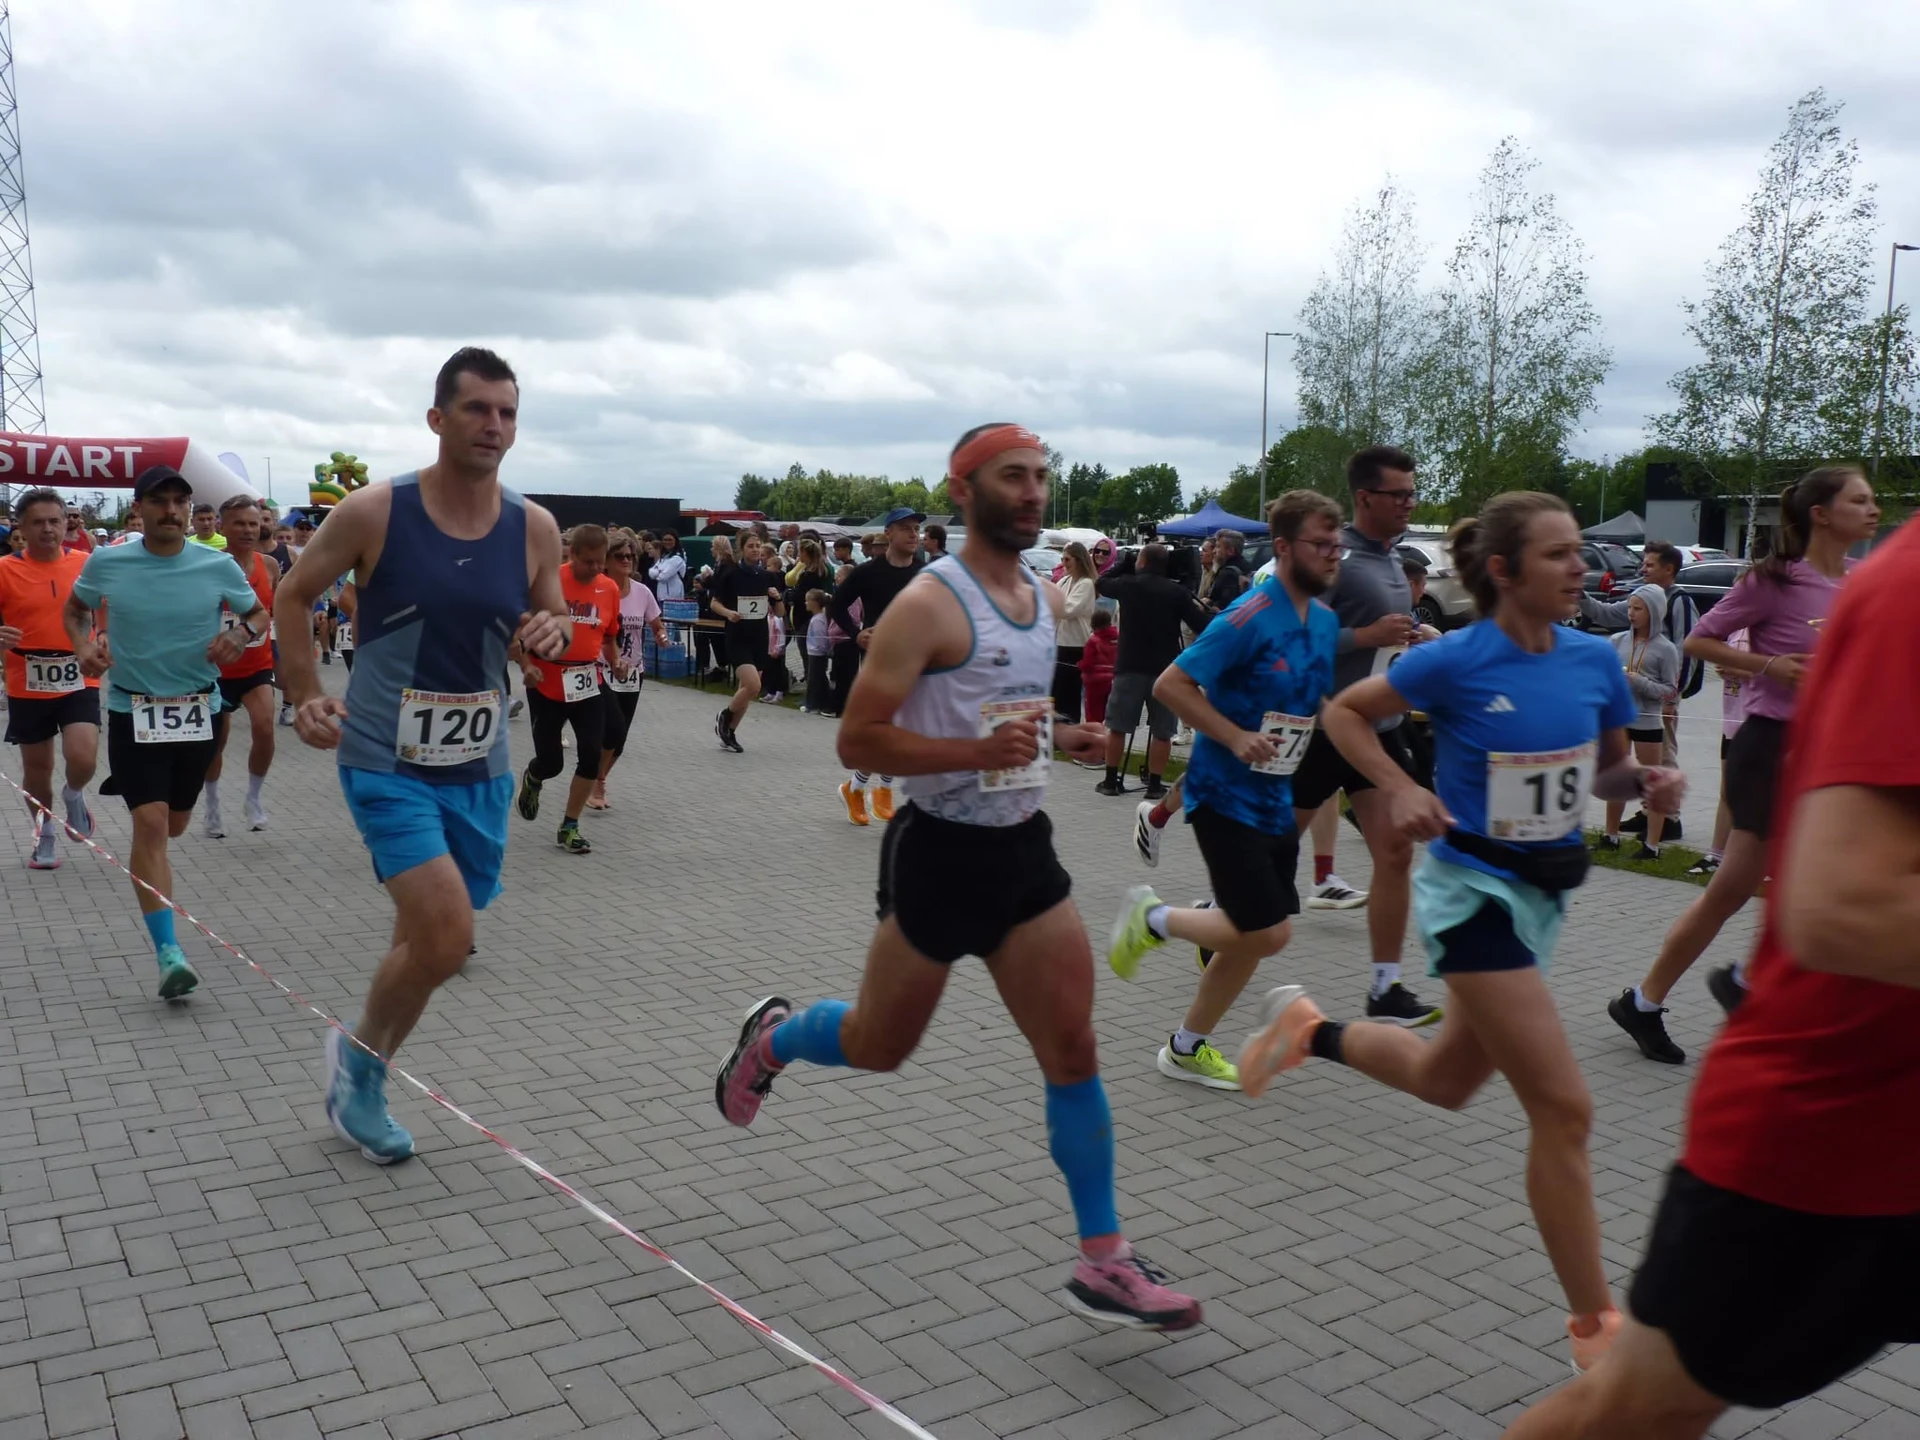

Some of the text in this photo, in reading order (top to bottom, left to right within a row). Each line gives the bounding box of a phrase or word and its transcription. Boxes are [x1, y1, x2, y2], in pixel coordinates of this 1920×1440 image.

[0, 438, 142, 479] START
[750, 601, 758, 613] 2
[340, 628, 353, 642] 15
[32, 663, 78, 683] 108
[574, 671, 592, 691] 36
[141, 704, 205, 730] 154
[413, 706, 493, 746] 120
[1523, 766, 1579, 816] 18
